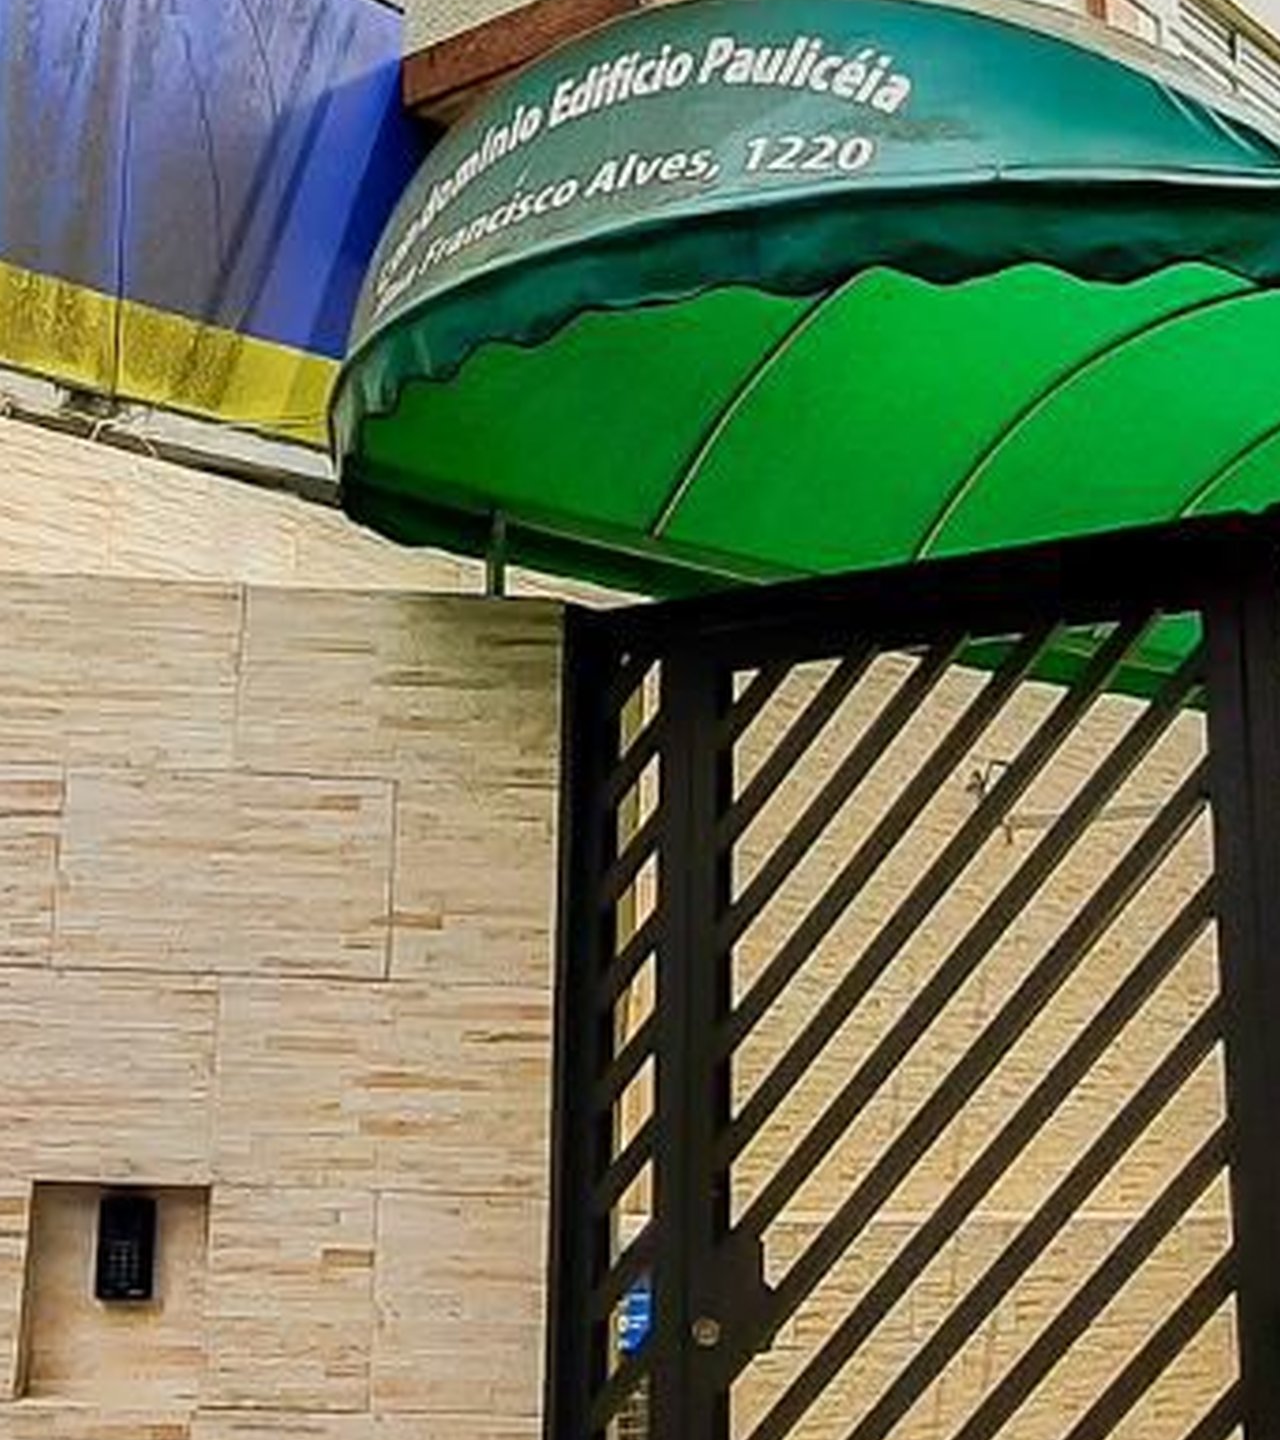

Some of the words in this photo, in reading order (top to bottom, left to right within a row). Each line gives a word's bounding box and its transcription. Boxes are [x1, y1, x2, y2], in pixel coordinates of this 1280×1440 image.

[698, 35, 911, 114] Paulicéia
[419, 178, 579, 276] Francisco
[583, 147, 720, 198] Alves,
[744, 134, 875, 172] 1220
